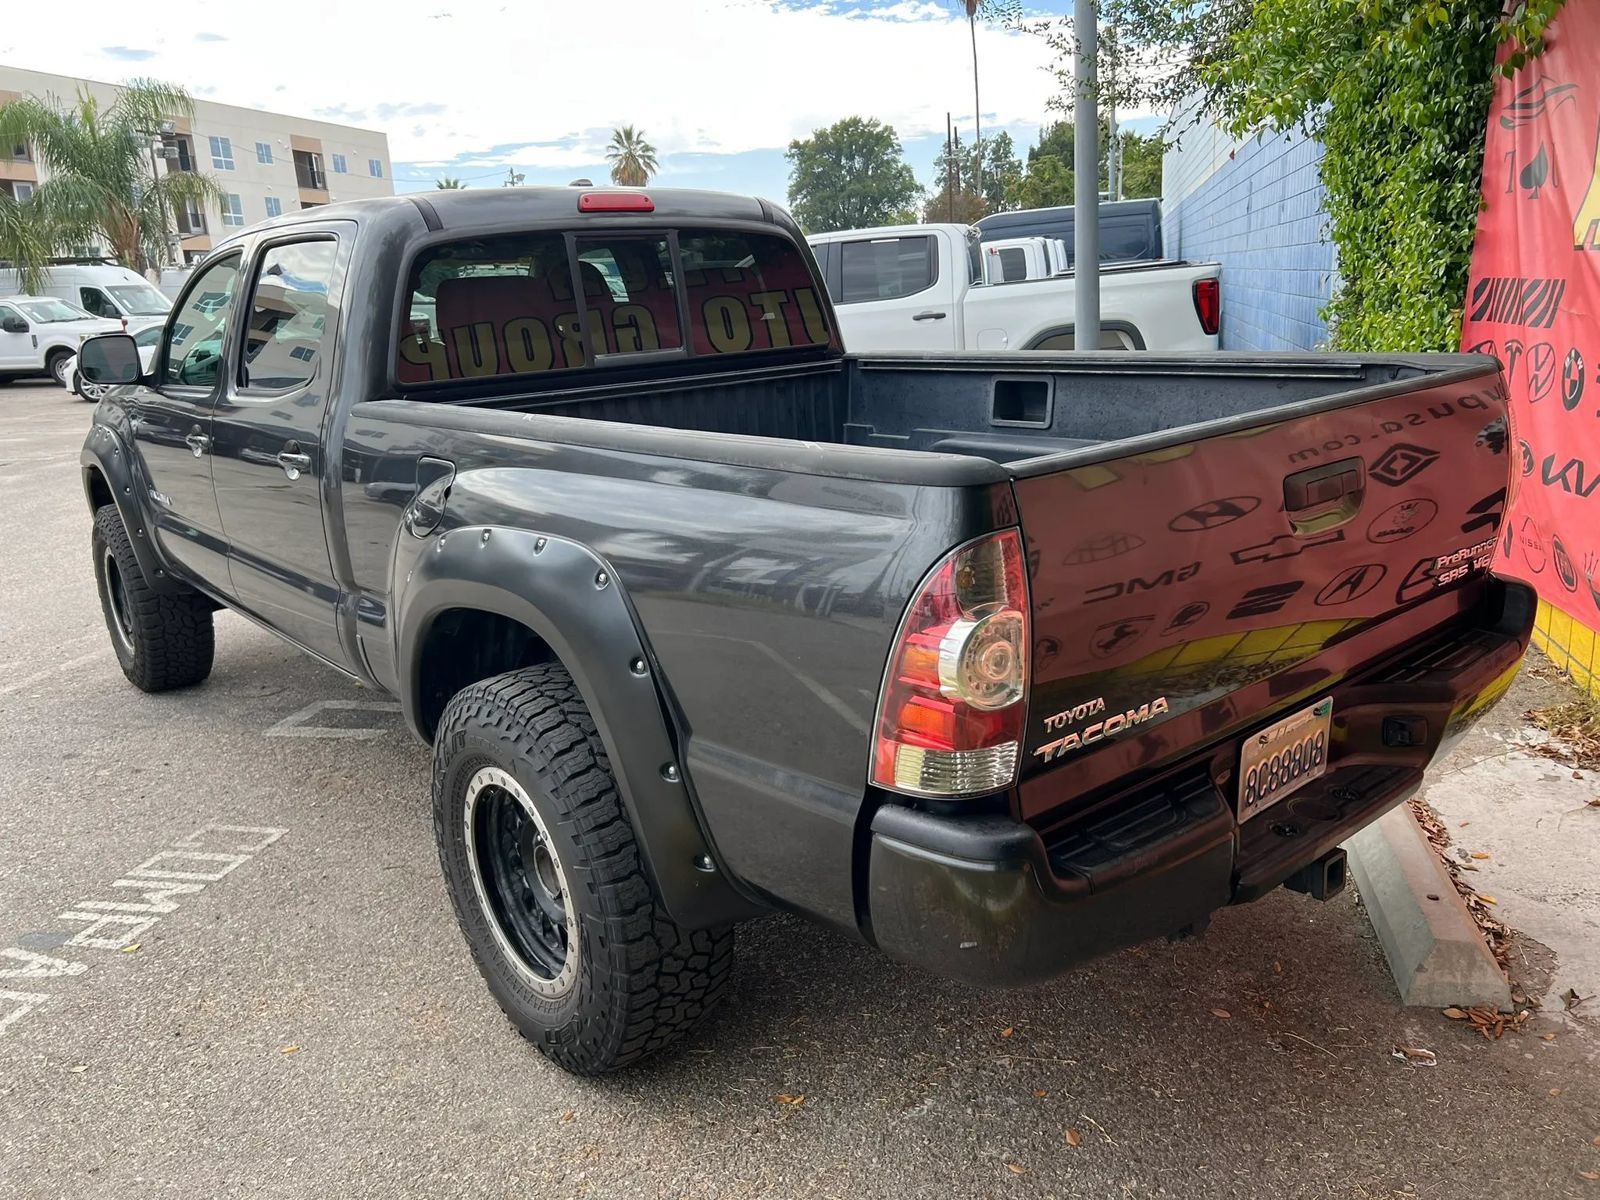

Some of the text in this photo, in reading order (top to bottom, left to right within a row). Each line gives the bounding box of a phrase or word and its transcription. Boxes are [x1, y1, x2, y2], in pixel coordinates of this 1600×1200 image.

[1520, 535, 1544, 552] NISS
[1438, 553, 1491, 587] SR5 V6
[1033, 696, 1170, 764] TACOMA
[1044, 696, 1106, 734] TOYOTA
[1245, 730, 1325, 806] 8C88808
